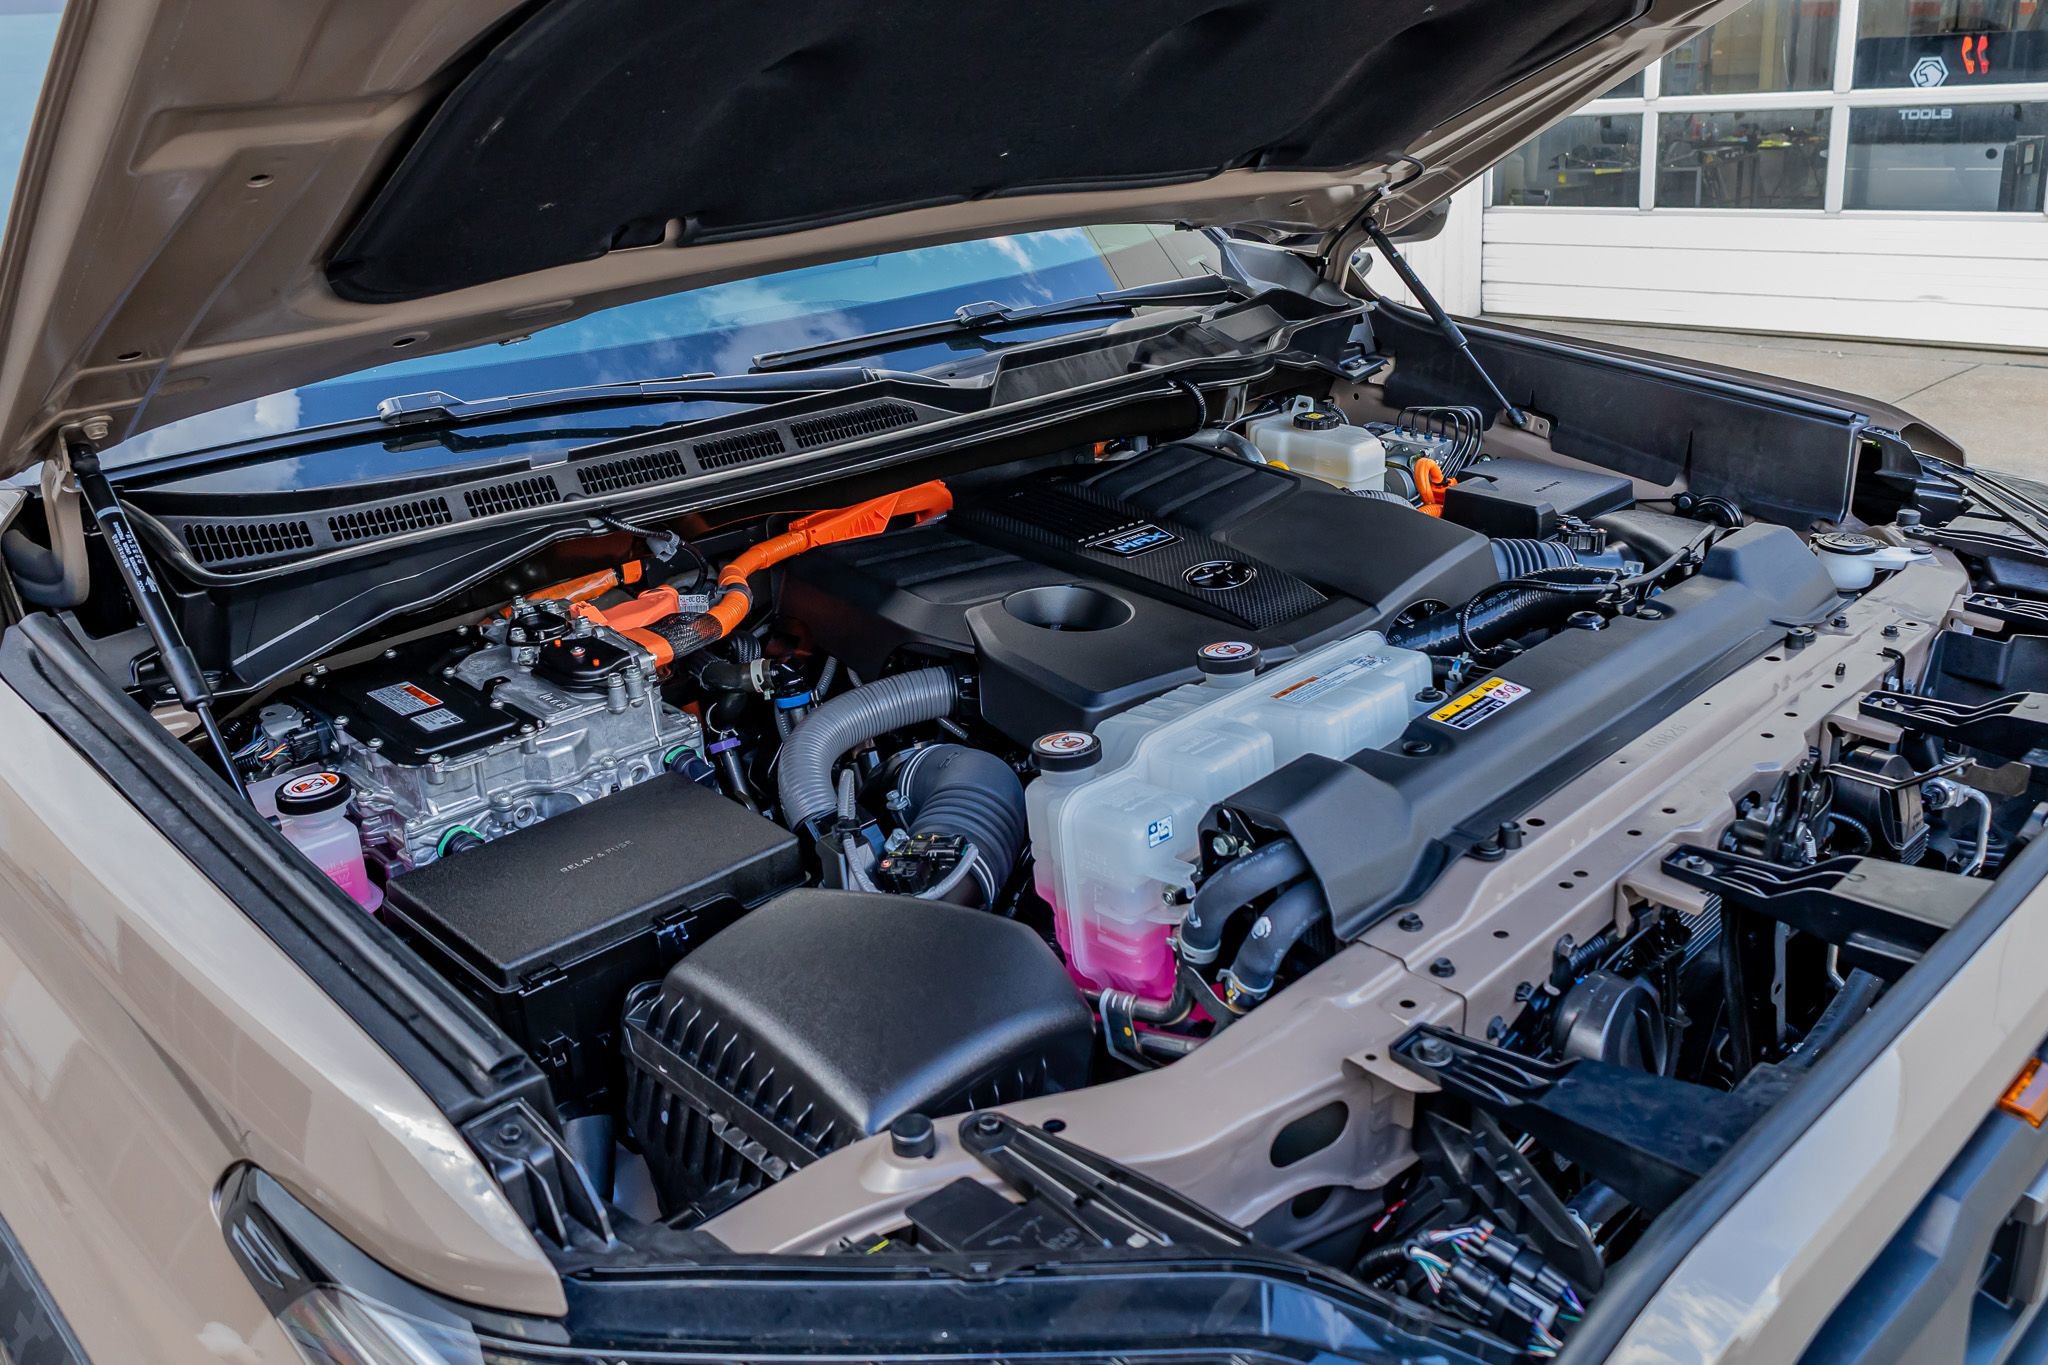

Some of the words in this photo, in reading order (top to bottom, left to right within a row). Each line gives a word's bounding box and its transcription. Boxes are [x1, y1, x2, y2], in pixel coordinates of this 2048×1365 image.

[1898, 108, 1953, 120] TOOLS
[1114, 531, 1168, 551] MAX
[560, 856, 593, 872] RELAY
